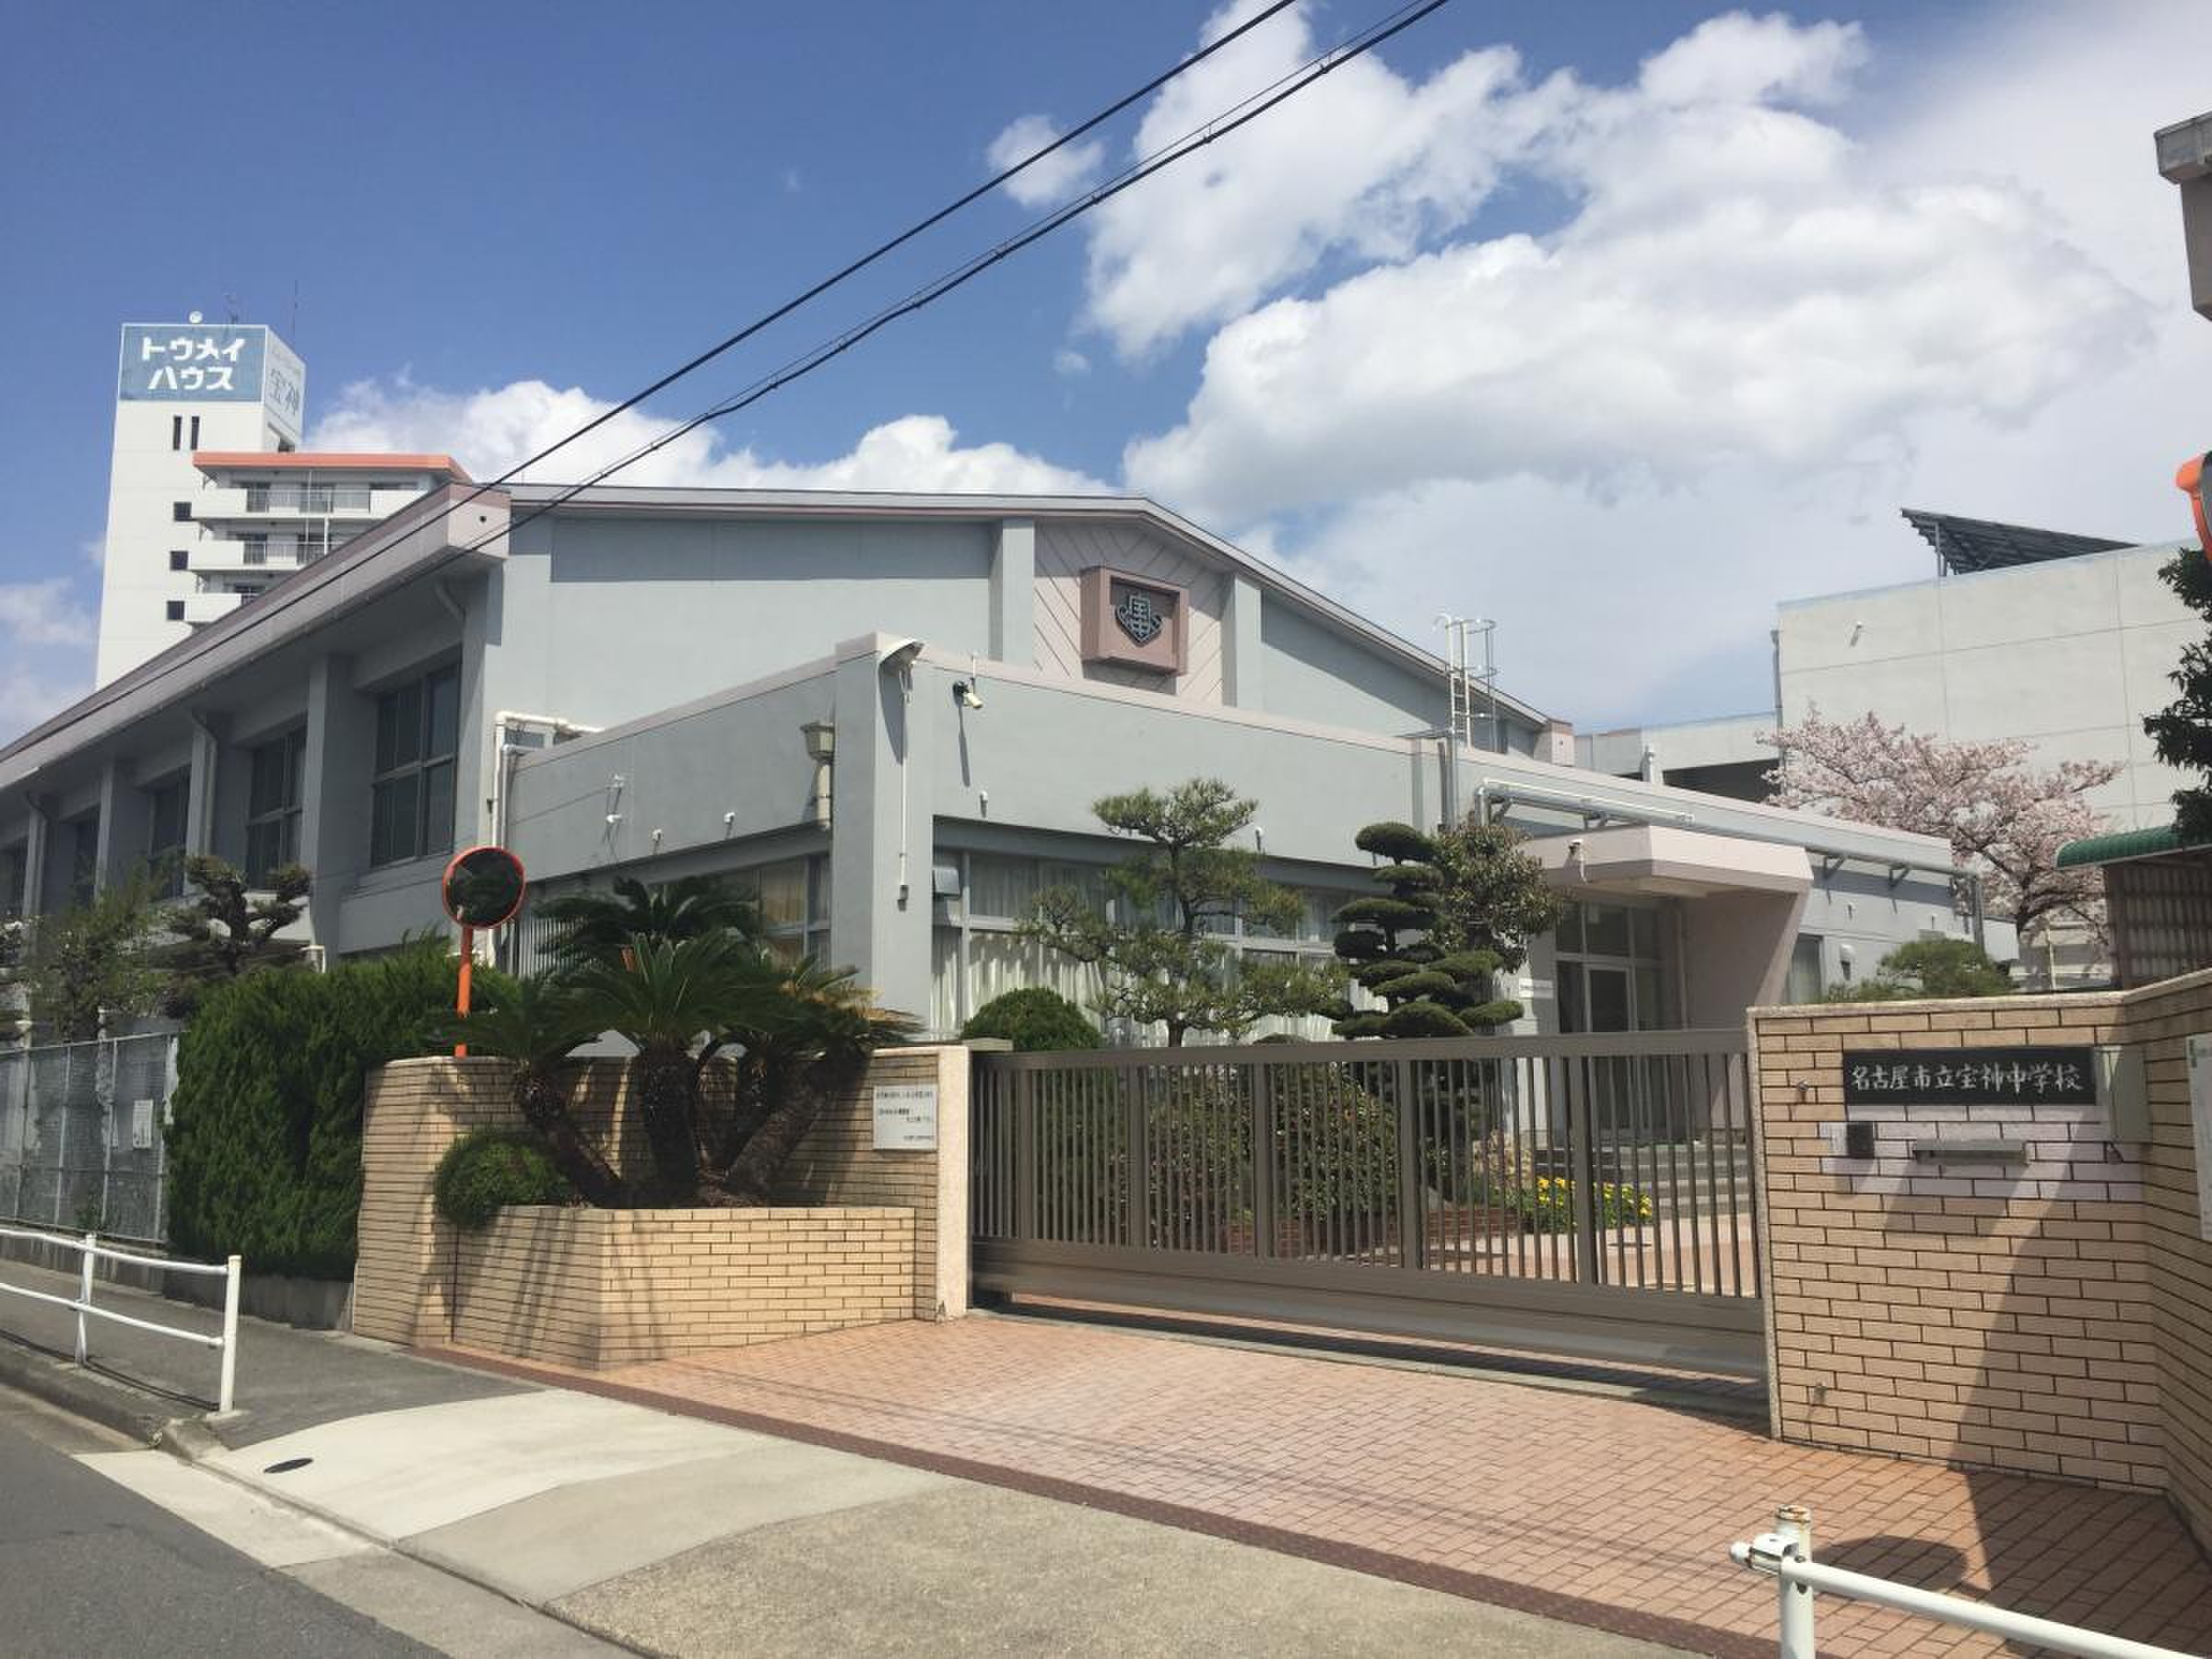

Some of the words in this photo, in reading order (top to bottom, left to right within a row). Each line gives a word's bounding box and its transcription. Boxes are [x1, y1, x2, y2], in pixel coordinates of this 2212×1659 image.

[142, 336, 246, 361] トウメイ
[147, 366, 234, 390] ハウス
[1852, 1062, 2083, 1093] 名古屋市立宝神中学校
